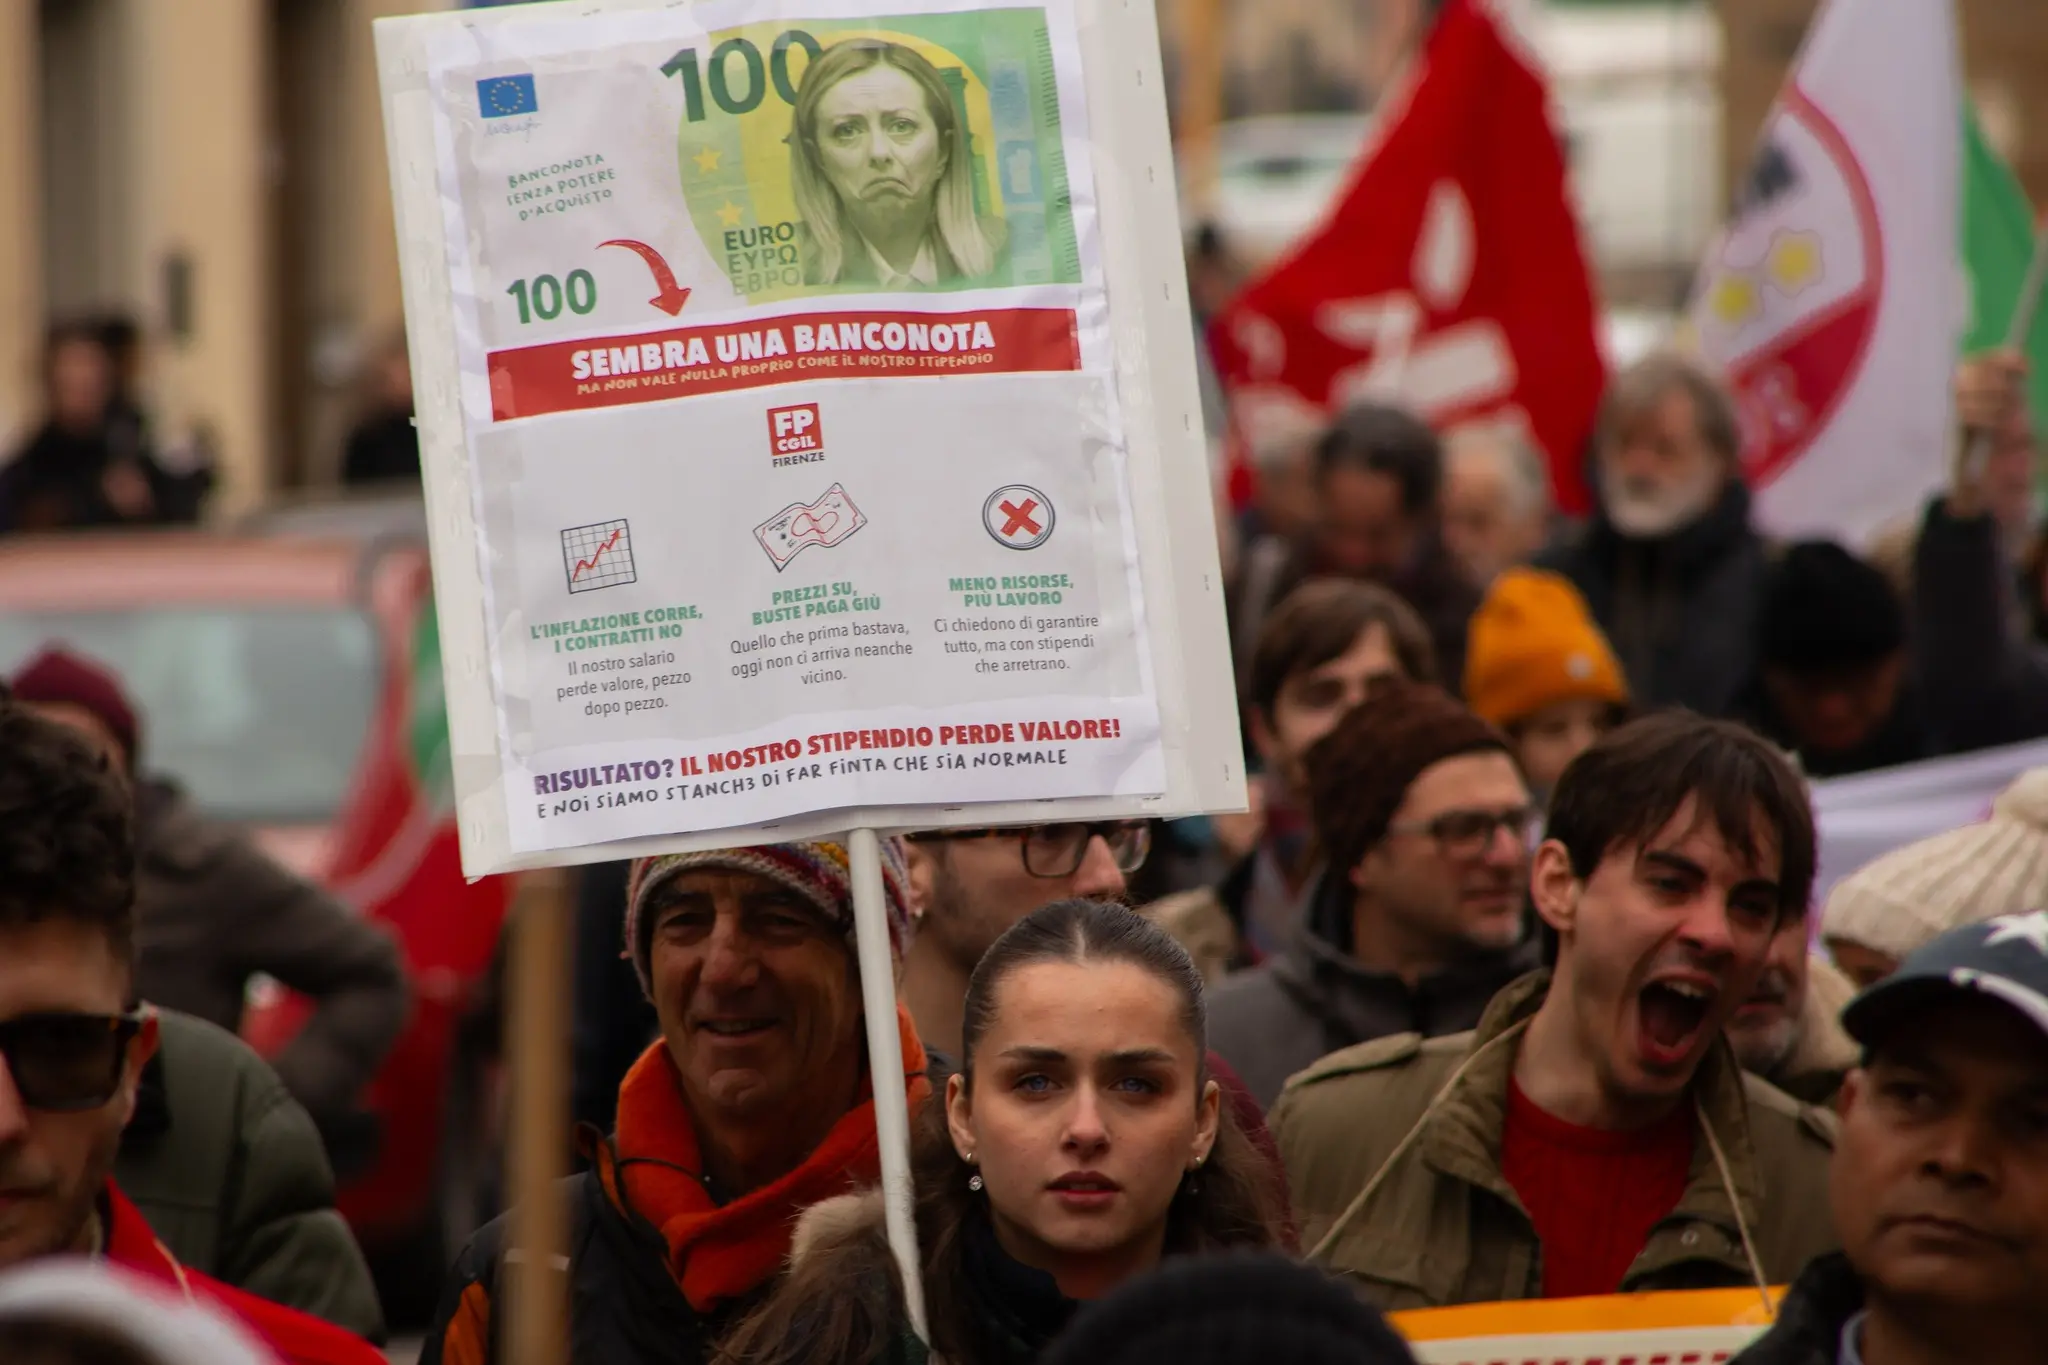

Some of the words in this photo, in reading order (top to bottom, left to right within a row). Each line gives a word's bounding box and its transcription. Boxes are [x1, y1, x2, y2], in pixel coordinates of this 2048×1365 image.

[660, 29, 822, 122] 100
[507, 154, 604, 188] BANCONOTA
[558, 168, 616, 194] POTERE
[724, 221, 794, 250] EURO
[506, 268, 597, 324] 100
[570, 337, 711, 380] SEMBRA
[715, 328, 788, 363] UNA
[793, 321, 996, 353] BANCONOTA
[577, 382, 601, 395] MA
[604, 378, 638, 391] NON
[642, 372, 677, 386] VALE
[680, 368, 728, 383] NULLA
[797, 355, 838, 369] COME
[859, 355, 916, 368] NOSTRO
[773, 409, 814, 438] FP
[777, 435, 816, 452] CGIL
[772, 451, 825, 468] FIRENZE
[772, 584, 828, 605] PREZZI
[832, 581, 858, 597] SU,
[949, 577, 997, 591] MENO
[1001, 574, 1074, 590] RISORSE,
[752, 605, 802, 626] BUSTE
[805, 599, 849, 617] PAGA
[852, 593, 881, 611] GIÙ
[964, 590, 992, 607] PIÙ
[996, 591, 1063, 607] LAVORO
[530, 612, 641, 640] L'INFLAZIONE
[643, 605, 704, 625] CORRE,
[934, 618, 948, 633] Ci
[952, 617, 1016, 632] chiedono
[1019, 616, 1033, 630] di
[1037, 614, 1099, 633] garantire
[554, 639, 561, 653] I
[564, 627, 654, 652] CONTRATTI
[658, 624, 683, 640] NO
[730, 634, 777, 655] Quello
[780, 630, 804, 645] che
[808, 625, 849, 645] prima
[852, 622, 910, 636] bastava,
[944, 640, 982, 654] tutto,
[984, 641, 1006, 651] ma
[1010, 639, 1034, 651] con
[1037, 634, 1095, 652] stipendi
[568, 661, 577, 676] Il
[581, 658, 626, 674] nostro
[628, 650, 675, 669] salario
[731, 658, 763, 679] oggi
[766, 656, 794, 670] non
[797, 650, 808, 665] ci
[811, 647, 851, 663] arriva
[854, 641, 913, 657] neanche
[975, 658, 999, 673] che
[1003, 658, 1071, 672] arretrano.
[556, 681, 598, 702] perde
[600, 677, 649, 693] valore,
[651, 672, 692, 691] pezzo
[801, 669, 848, 685] vicino.
[584, 702, 621, 717] dopo
[624, 697, 669, 715] pezzo.
[534, 758, 674, 795] RISULTATO?
[680, 756, 702, 776] IL
[707, 738, 802, 773] NOSTRO
[807, 726, 933, 755] STIPENDIO
[939, 722, 1014, 745] PERDE
[1018, 718, 1121, 742] VALORE!
[537, 803, 546, 818] E
[787, 763, 822, 783] FAR
[893, 754, 928, 771] CHE
[973, 748, 1068, 767] NORMALE
